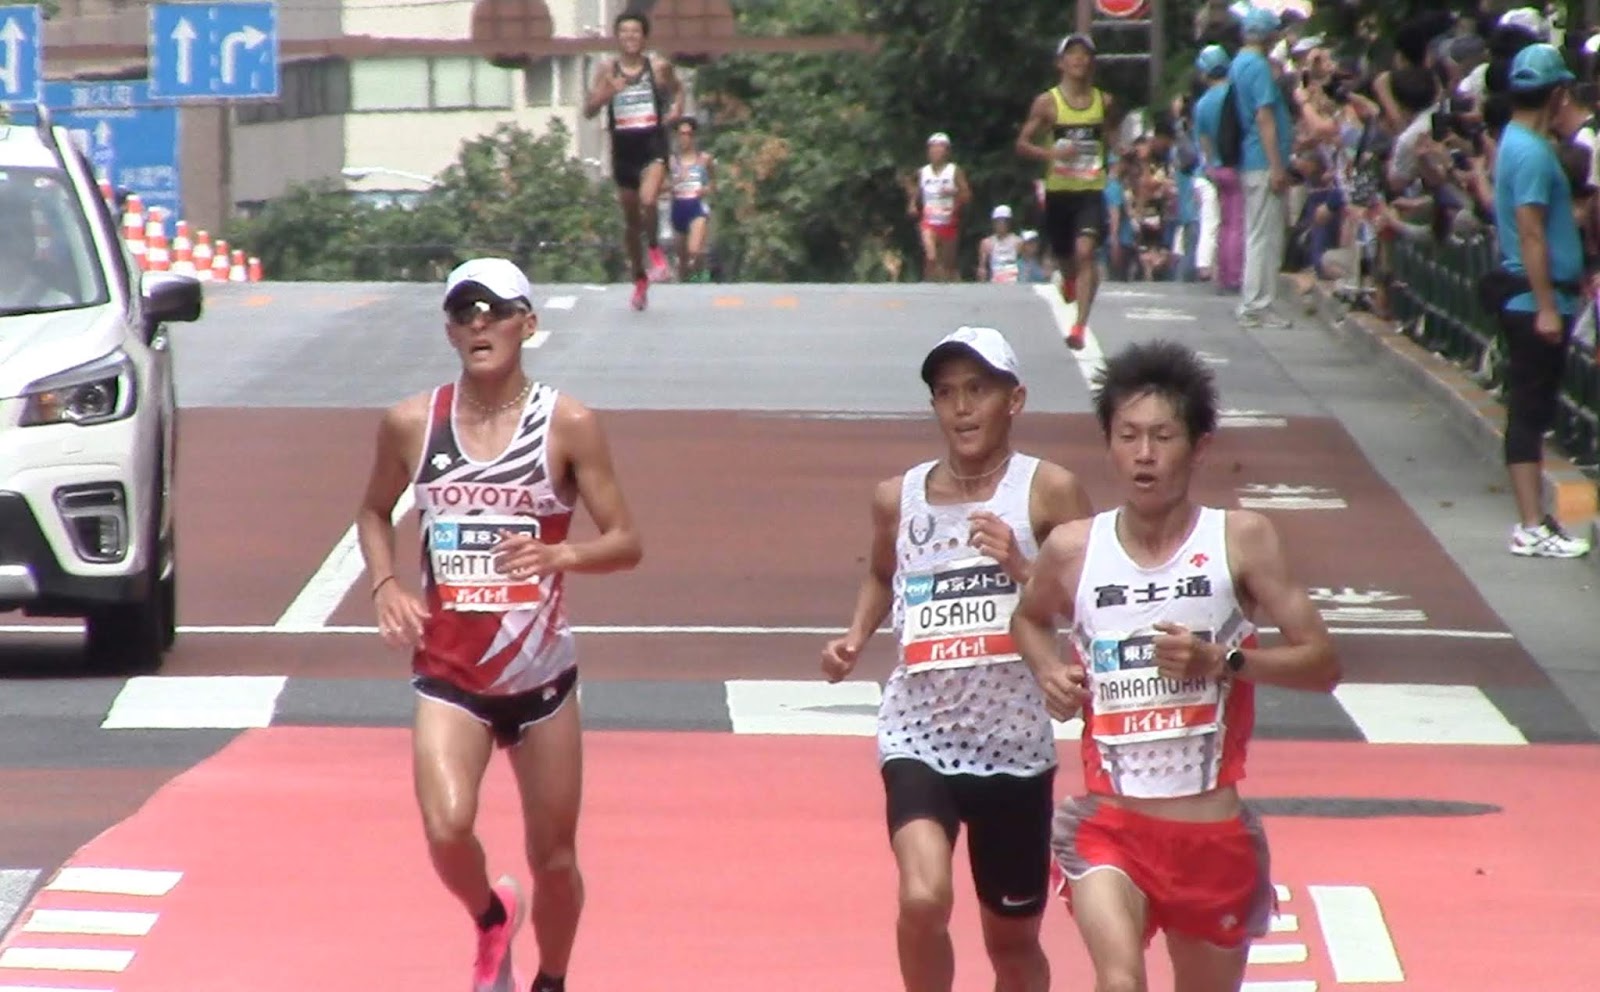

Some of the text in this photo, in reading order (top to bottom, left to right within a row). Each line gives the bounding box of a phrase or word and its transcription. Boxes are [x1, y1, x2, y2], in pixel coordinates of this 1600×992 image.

[427, 486, 535, 509] TOYOTA
[934, 573, 1010, 594] 東京メトロ
[1093, 574, 1213, 608] 富士通
[920, 600, 996, 629] OSAKO
[930, 637, 986, 661] バイトル
[1123, 708, 1185, 733] バイトル
